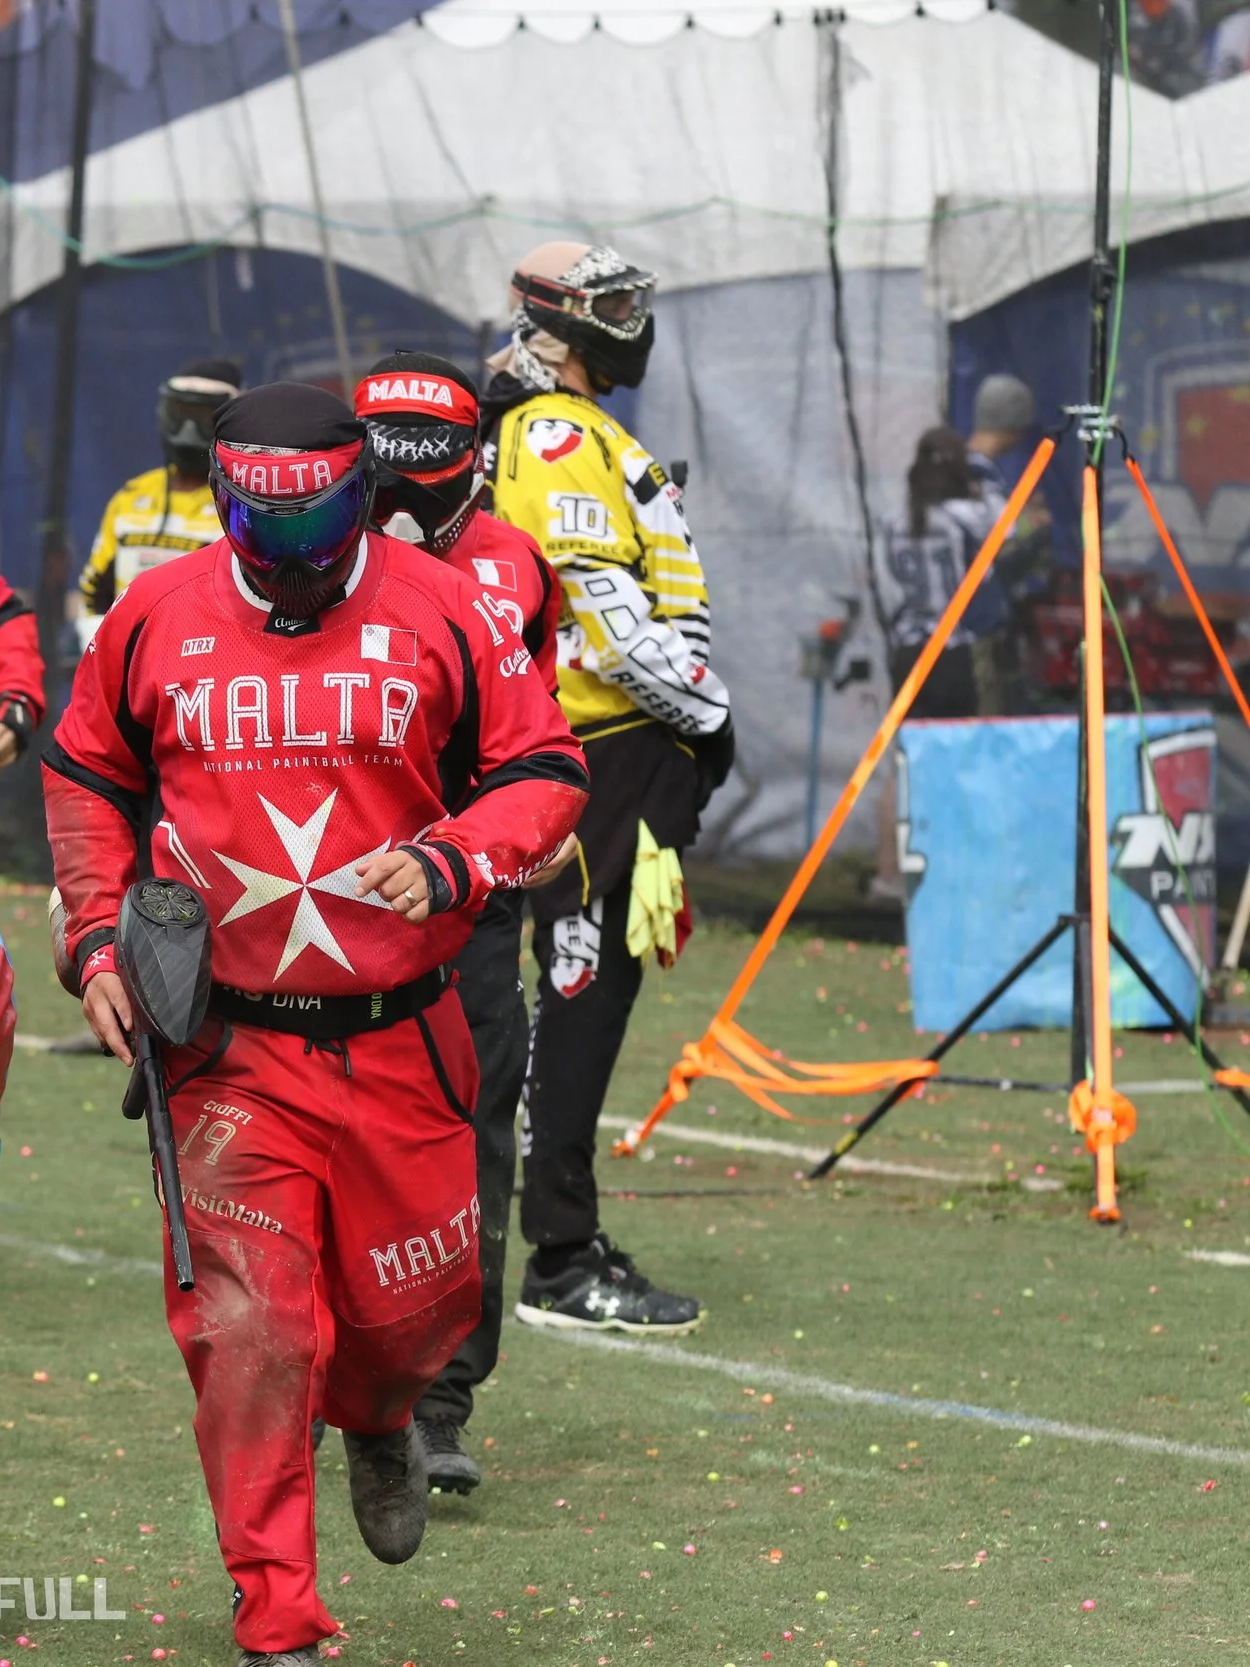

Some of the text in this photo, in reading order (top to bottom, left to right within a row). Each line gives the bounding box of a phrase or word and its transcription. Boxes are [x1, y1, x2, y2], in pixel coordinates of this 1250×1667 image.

[368, 379, 453, 408] MALTA
[232, 460, 334, 495] MALTA
[558, 496, 608, 538] 10
[182, 637, 215, 656] NTRX
[165, 672, 419, 751] MALTA
[203, 754, 403, 773] NTIONAL PAINTBALL TEAM
[203, 1100, 253, 1126] CIOFFI
[178, 1114, 237, 1166] 19
[369, 1193, 481, 1287] MALTA
[393, 1276, 432, 1295] NATIONAL
